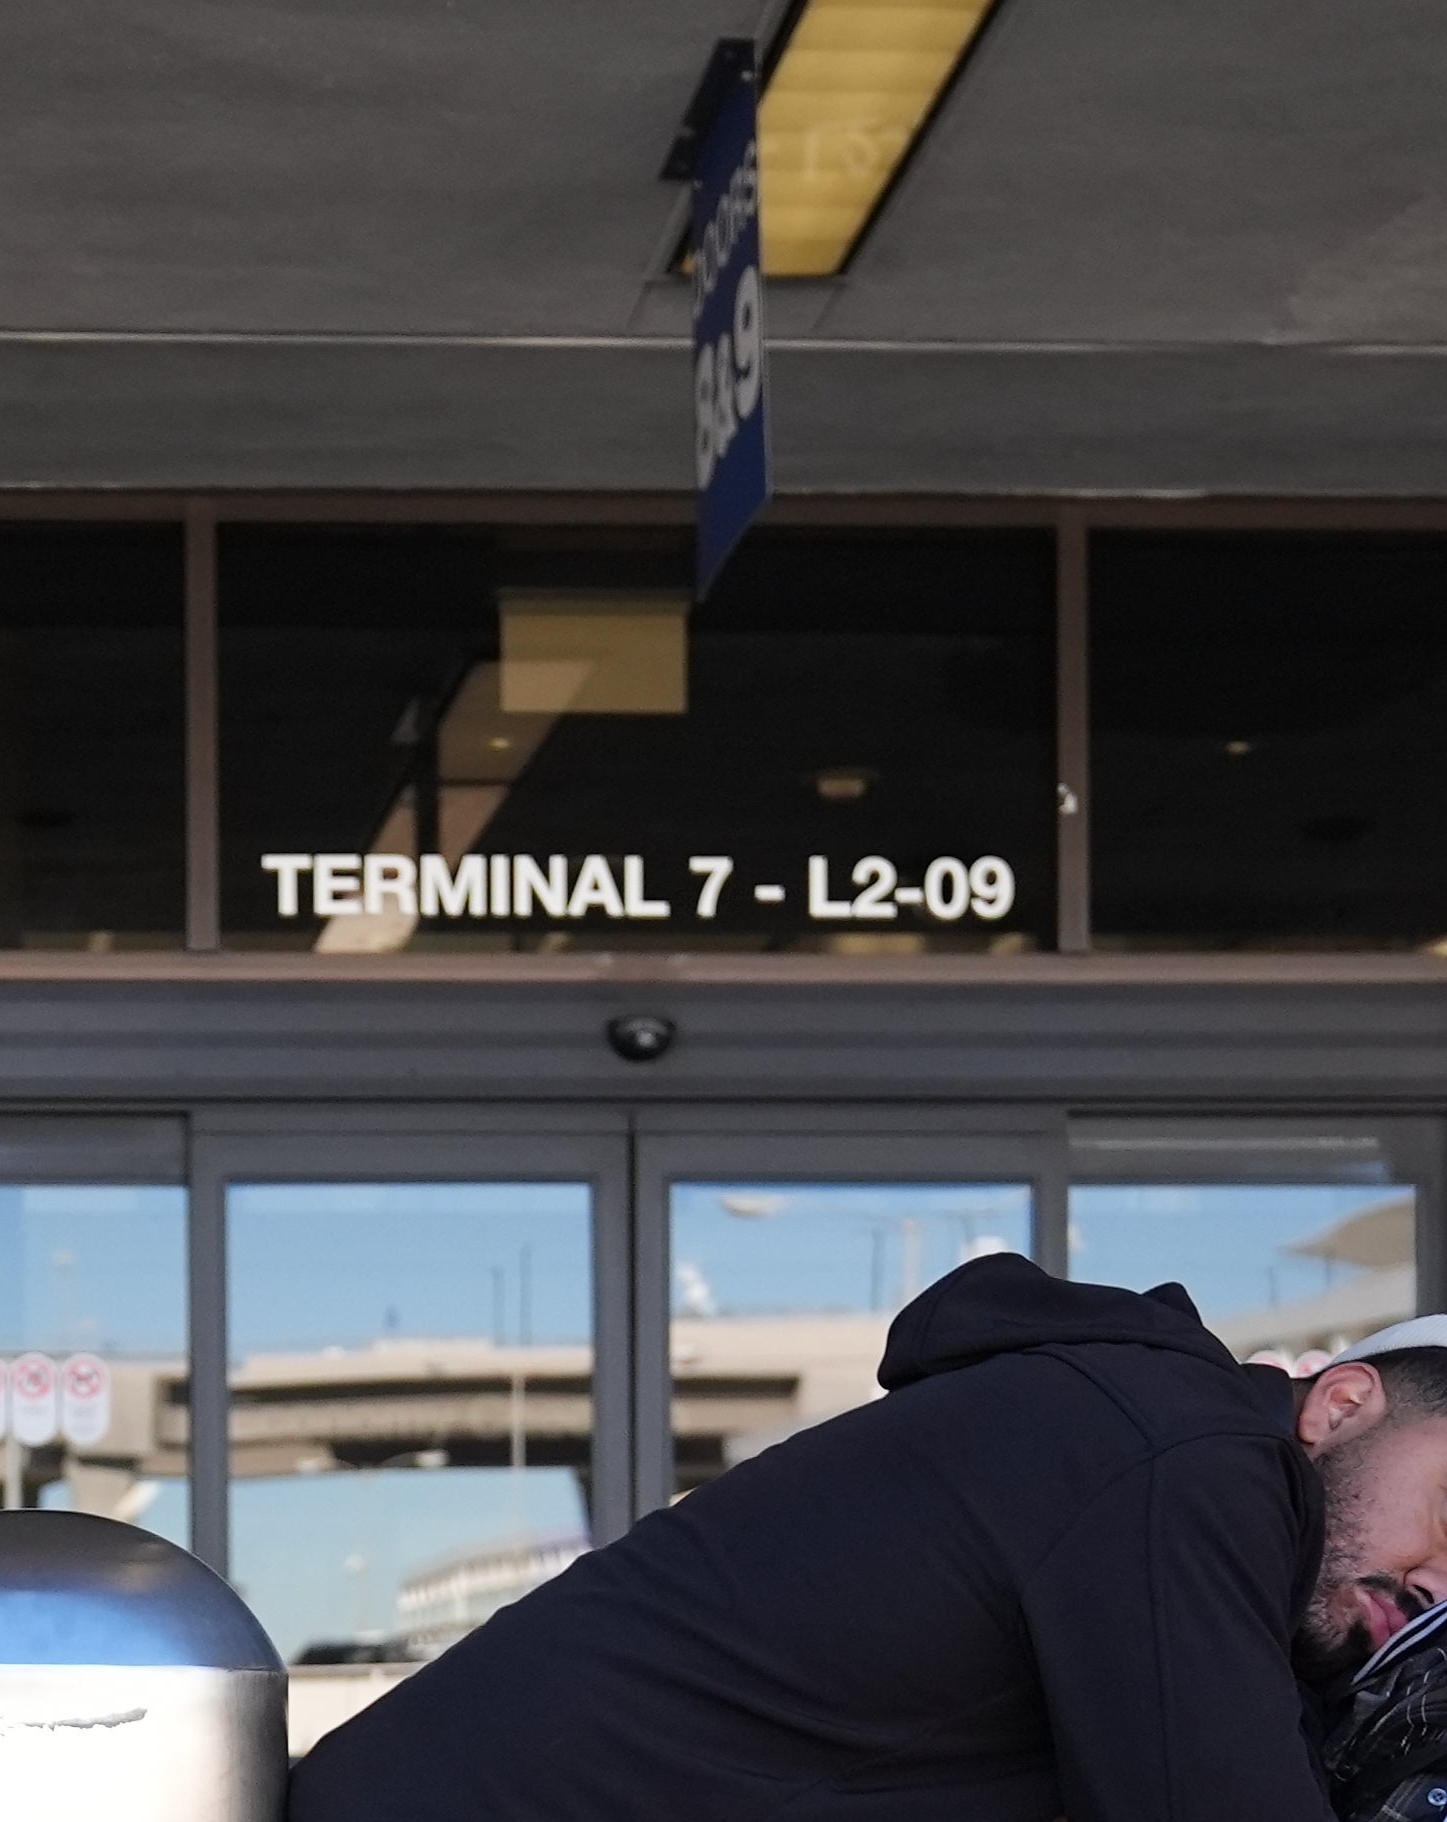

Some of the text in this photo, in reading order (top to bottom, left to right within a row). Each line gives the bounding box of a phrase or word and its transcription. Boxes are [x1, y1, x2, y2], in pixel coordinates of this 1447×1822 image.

[262, 852, 1016, 921] TERMINAL 7 - L2-09
